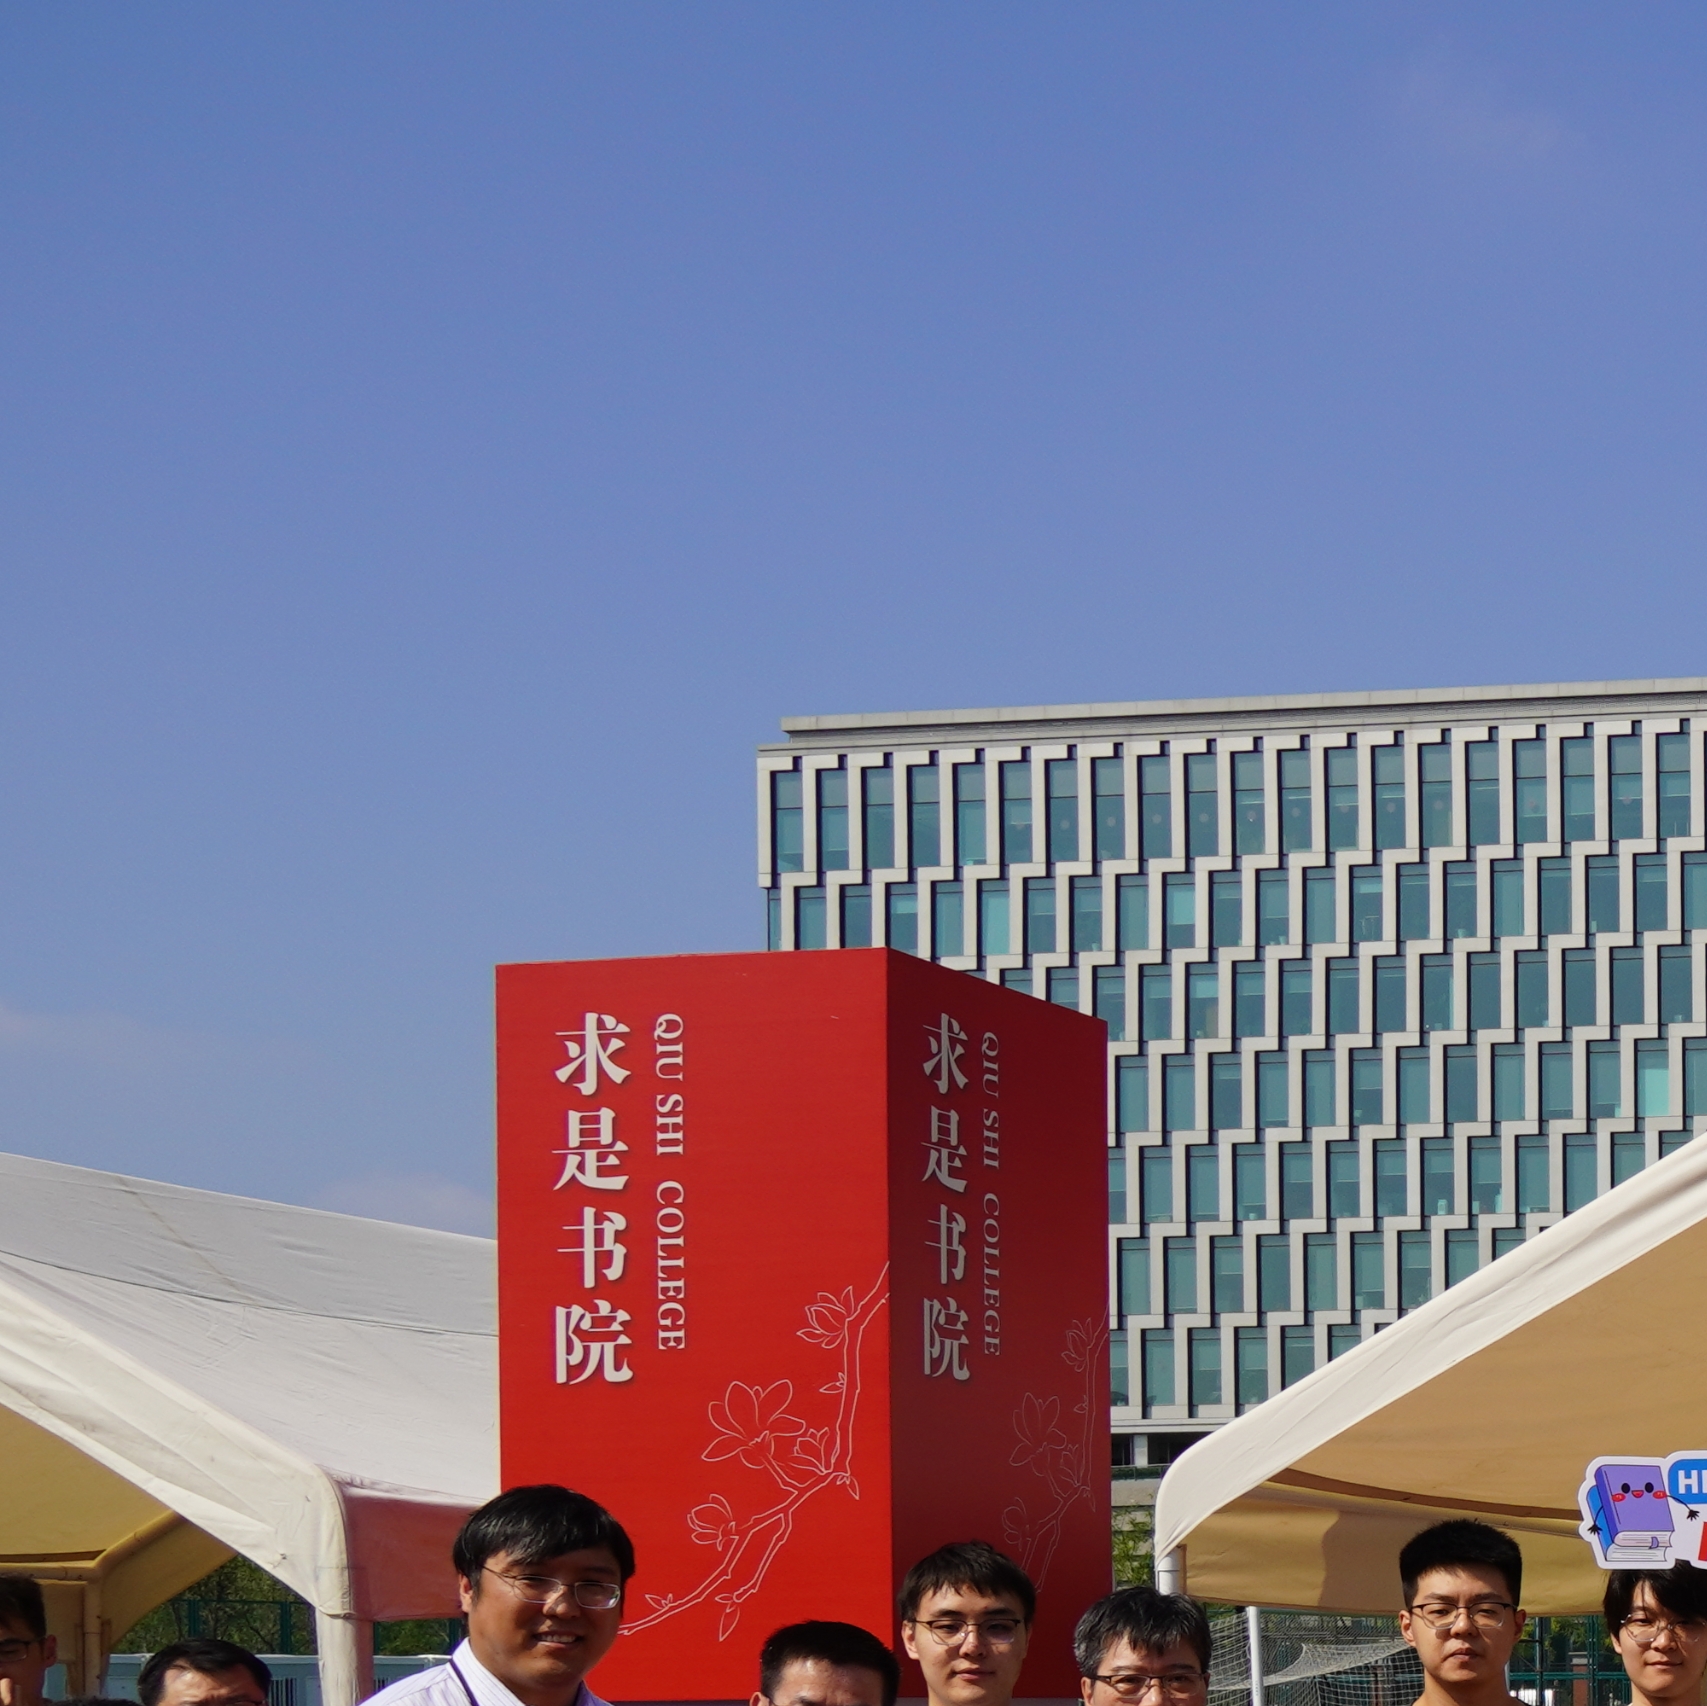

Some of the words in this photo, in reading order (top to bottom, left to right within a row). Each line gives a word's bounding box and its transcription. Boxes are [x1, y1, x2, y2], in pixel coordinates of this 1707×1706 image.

[653, 1013, 685, 1082] QIU
[981, 1030, 1000, 1098] QIU
[654, 1093, 685, 1156] SHI
[982, 1109, 1000, 1169] SHI
[552, 1012, 634, 1385] 求是书院
[920, 1012, 971, 1382] 求是书院
[656, 1180, 686, 1351] COLLEGE
[983, 1192, 1002, 1357] COLLEGE
